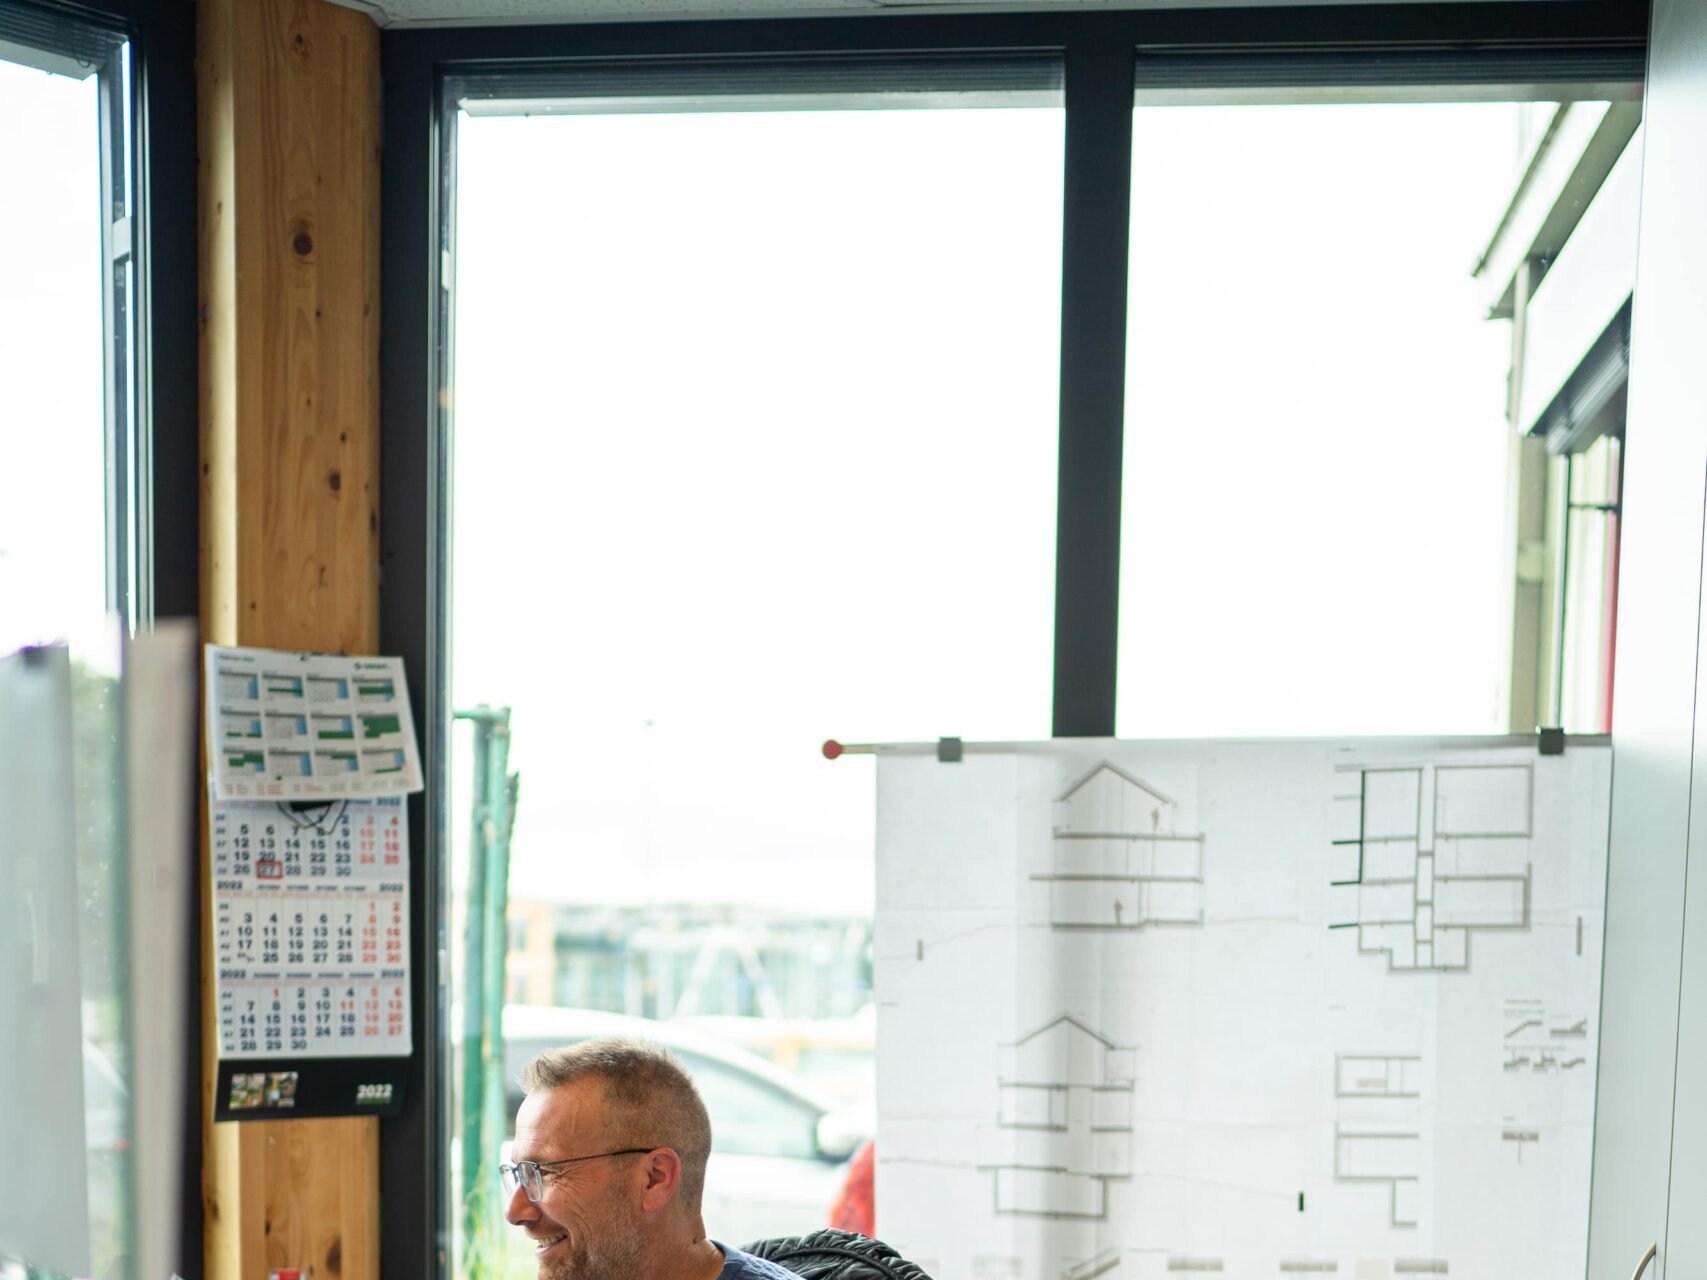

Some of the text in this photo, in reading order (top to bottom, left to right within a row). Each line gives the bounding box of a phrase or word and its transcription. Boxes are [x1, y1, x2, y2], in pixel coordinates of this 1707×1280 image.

[238, 927, 252, 936] 10
[263, 927, 277, 937] 11
[288, 927, 303, 937] 12
[238, 940, 252, 949] 17
[241, 1015, 255, 1024] 14
[357, 1084, 392, 1099] 2022
